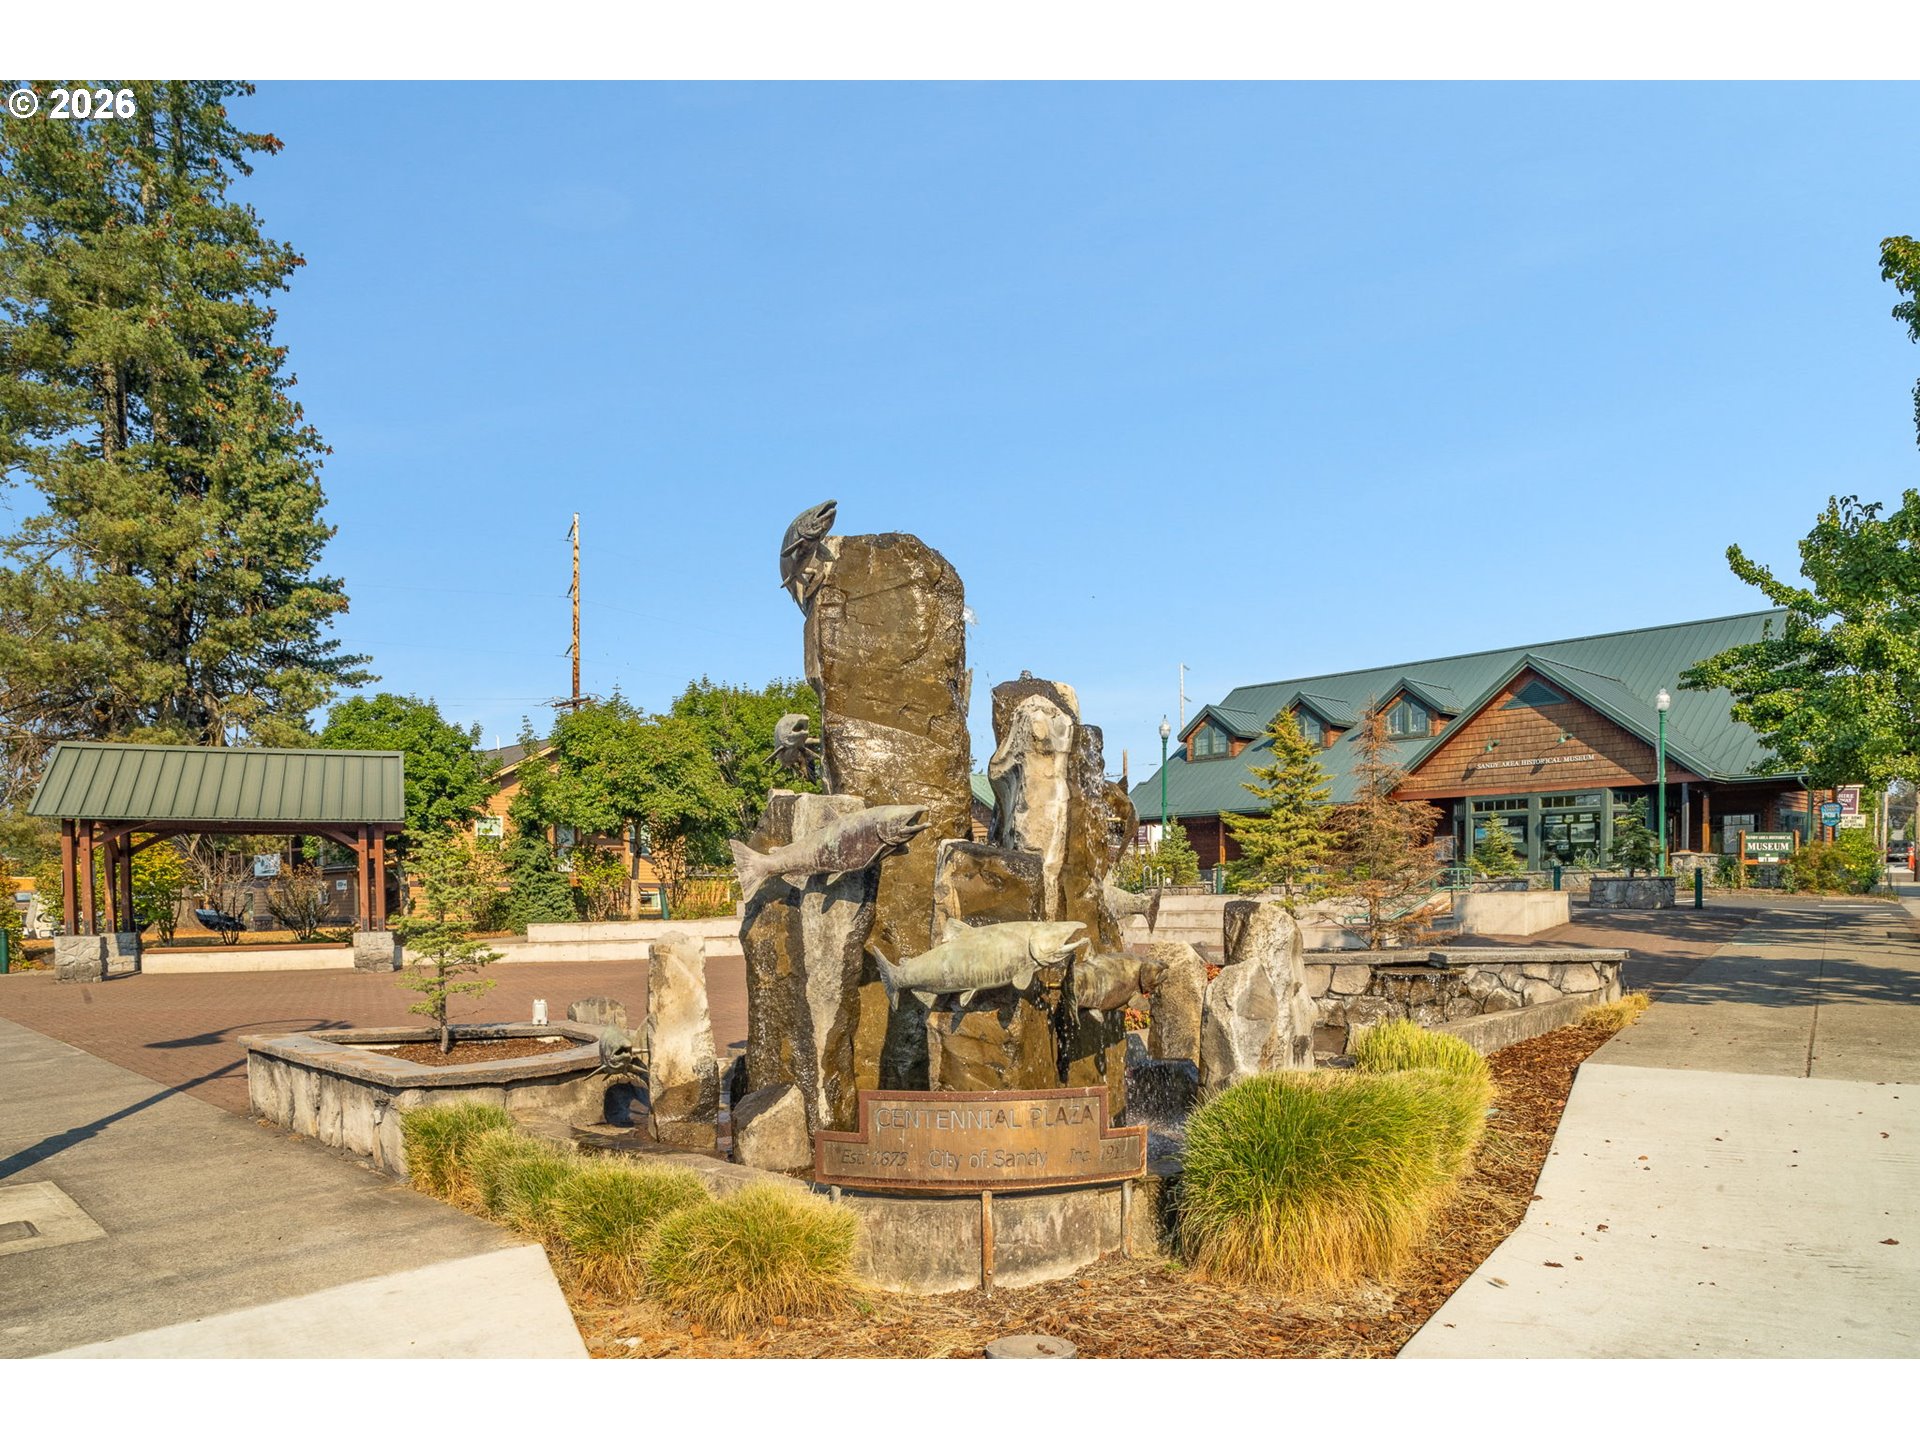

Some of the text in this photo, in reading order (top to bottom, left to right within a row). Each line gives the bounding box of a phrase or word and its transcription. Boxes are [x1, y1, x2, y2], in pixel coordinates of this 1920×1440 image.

[1477, 762, 1499, 770] SANDY
[1521, 757, 1562, 766] HISTORICAL
[1563, 754, 1595, 763] MUSEUM
[1747, 842, 1789, 851] MUSEUM
[876, 1104, 1095, 1131] CENTENNIAL PLAZA
[928, 1148, 963, 1173] City
[969, 1148, 988, 1169] of
[993, 1147, 1048, 1168] Sandy
